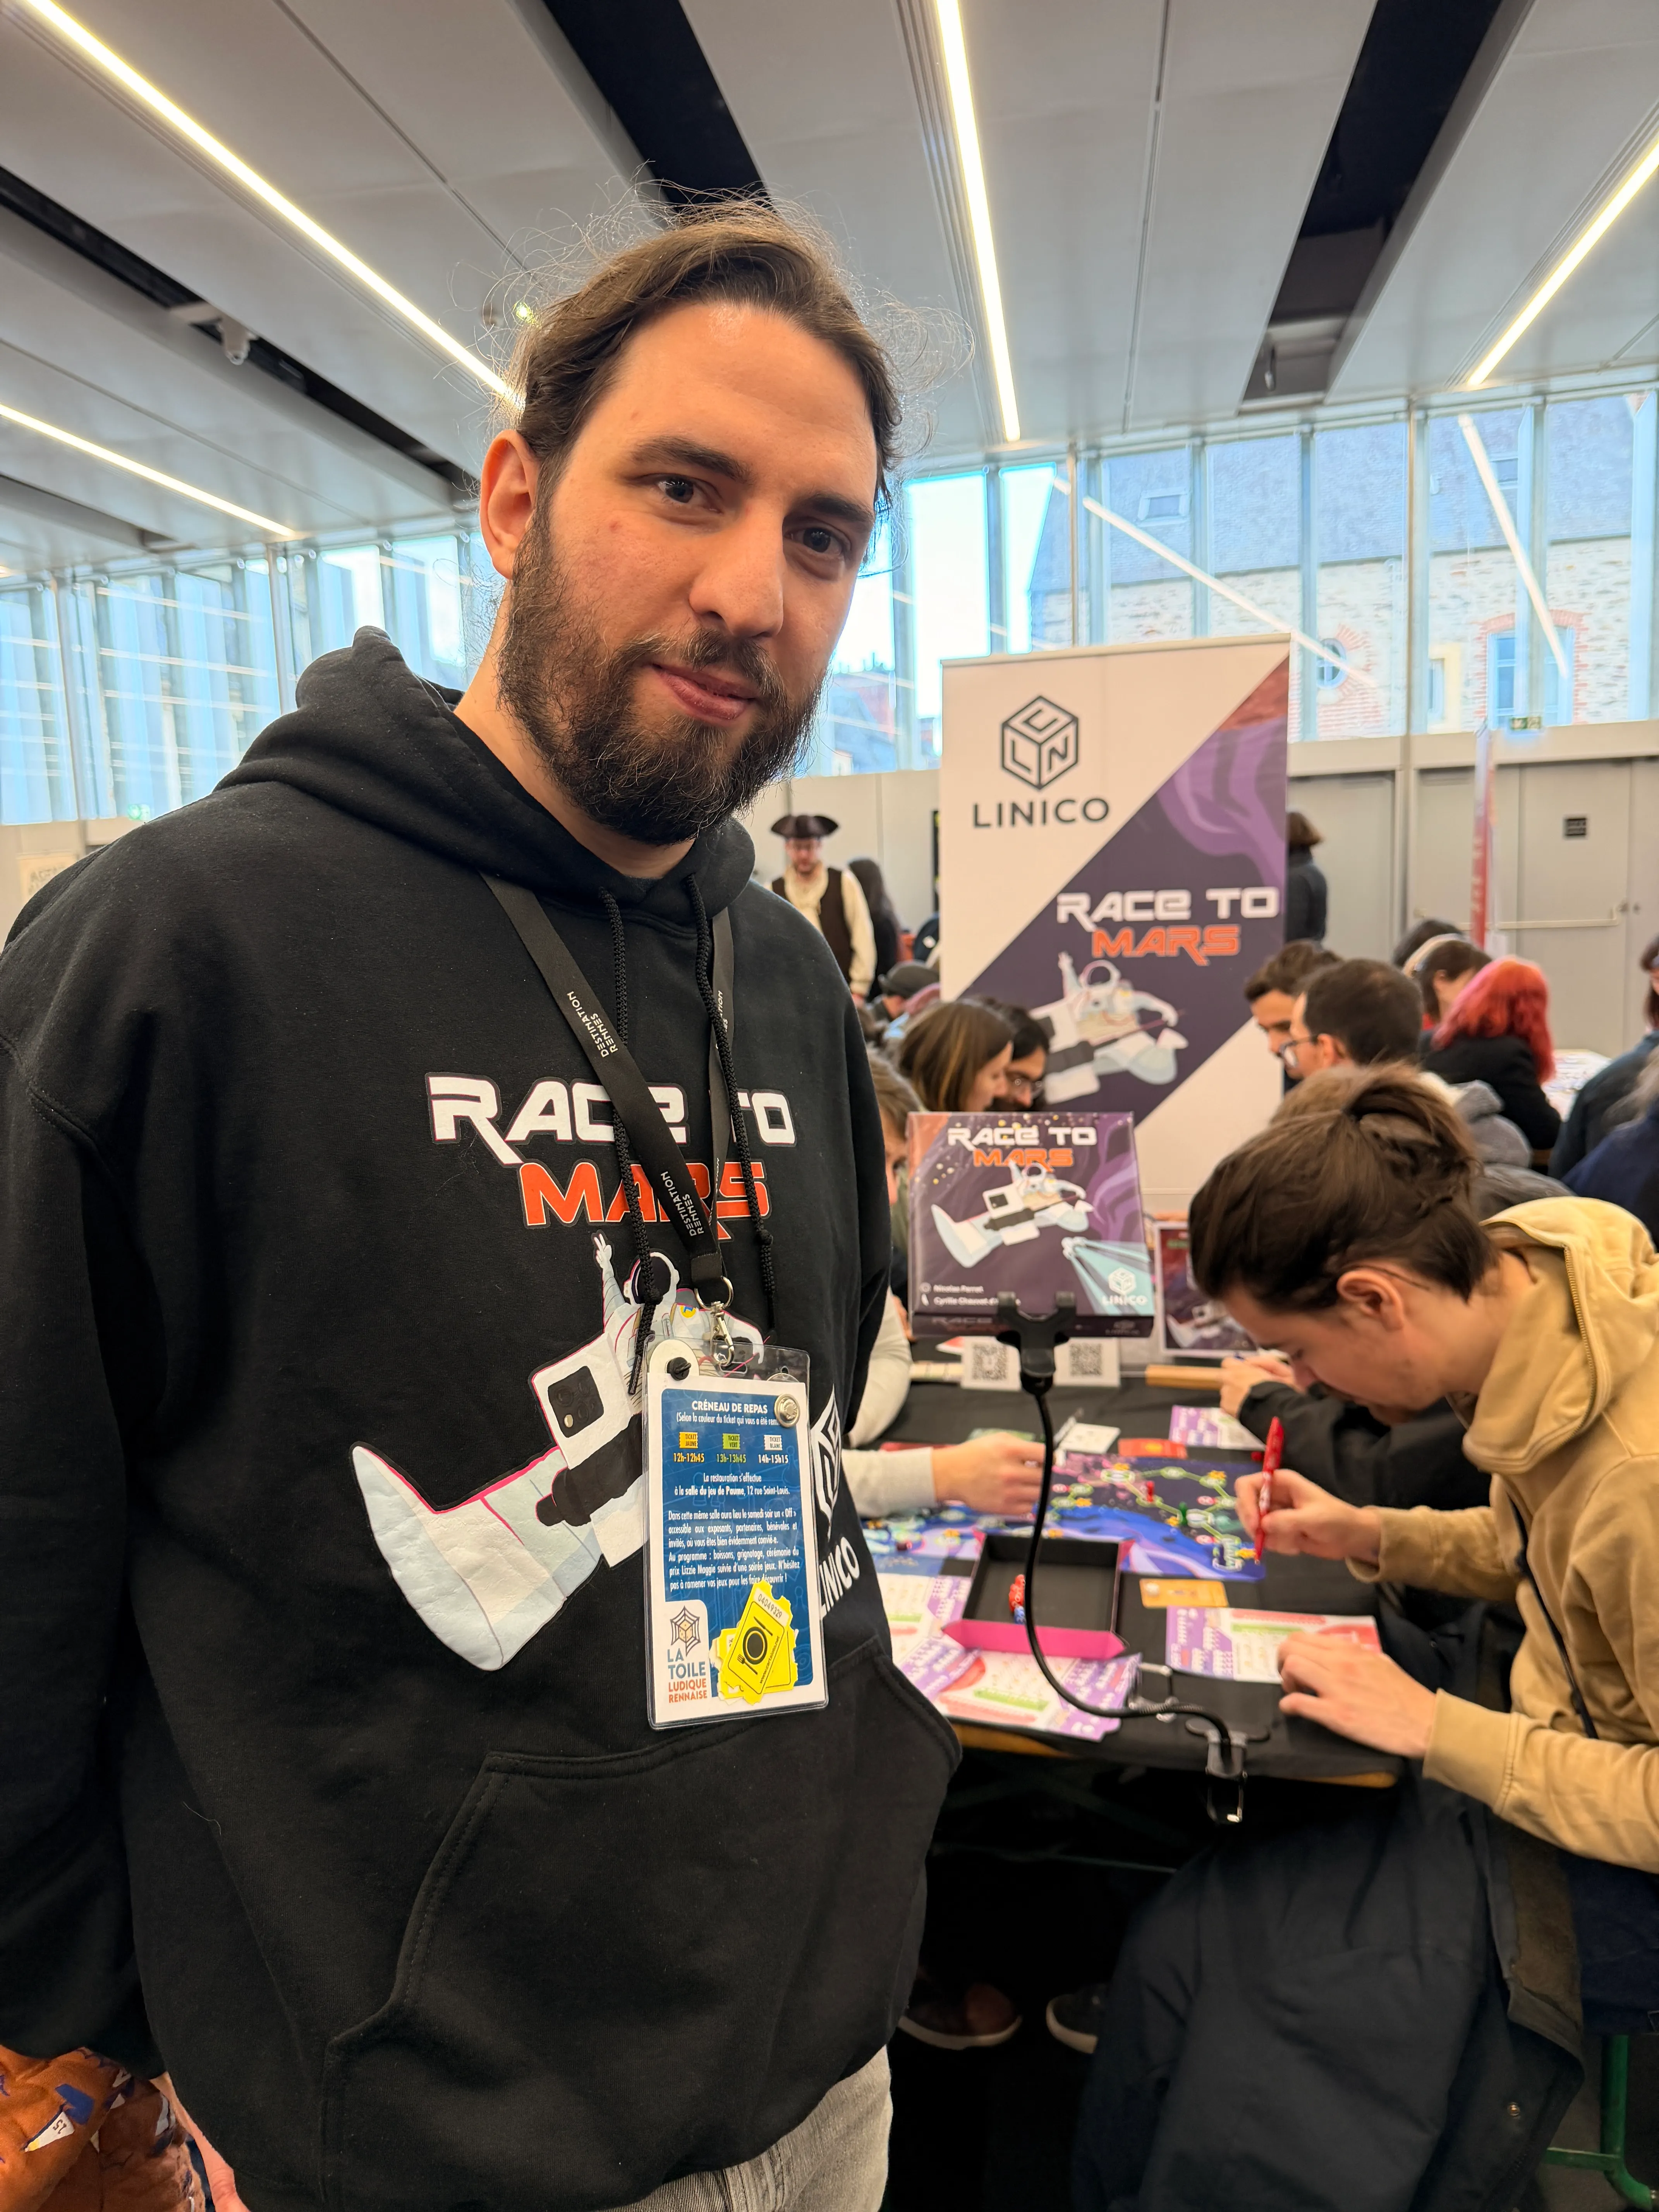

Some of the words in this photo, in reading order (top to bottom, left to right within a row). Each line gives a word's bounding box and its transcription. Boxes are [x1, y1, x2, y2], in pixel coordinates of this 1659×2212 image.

[973, 798, 1110, 828] LINICO
[1056, 890, 1192, 932] RACE
[1206, 886, 1279, 919] TO
[1092, 924, 1241, 966] MARS
[567, 991, 609, 1057] DESTINATION
[591, 1013, 618, 1053] RENNES
[947, 1127, 1040, 1151] RACE
[1048, 1127, 1097, 1146] TO
[973, 1148, 1073, 1173] MARS
[661, 1171, 696, 1236] DESTINATION
[683, 1194, 704, 1234] RENNES
[692, 1399, 730, 1412] CRÉNEAU
[732, 1403, 742, 1412] DE
[744, 1403, 768, 1414] REPAS
[677, 1411, 691, 1422] (Selon
[692, 1412, 697, 1422] la
[698, 1413, 715, 1423] couleur
[716, 1413, 722, 1423] du
[723, 1415, 735, 1424] ticket
[673, 1452, 704, 1462] 12h-12h45
[717, 1453, 746, 1463] 13h-13h45
[758, 1454, 788, 1463] 14h-15h15
[703, 1473, 709, 1482] La
[710, 1473, 738, 1482] restauration
[739, 1472, 762, 1482] s'effectue
[675, 1486, 678, 1495] à
[679, 1485, 684, 1495] la
[685, 1485, 698, 1495] salle
[699, 1485, 706, 1495] du
[708, 1486, 716, 1498] jeu
[718, 1485, 724, 1495] de
[726, 1486, 746, 1496] Paume,
[747, 1486, 754, 1495] 12
[763, 1486, 790, 1495] Saint-Louis.
[668, 1510, 680, 1520] Dans
[681, 1511, 693, 1520] cette
[694, 1510, 708, 1519] même
[709, 1509, 720, 1519] salle
[733, 1509, 741, 1519] lieu
[742, 1508, 747, 1518] le
[747, 1508, 764, 1518] samedi
[764, 1509, 773, 1518] soir
[668, 1523, 691, 1534] accessible
[708, 1524, 733, 1534] exposants,
[736, 1522, 763, 1534] partenaires,
[766, 1520, 789, 1531] bénévoles
[792, 1522, 797, 1530] et
[668, 1538, 685, 1549] invités,
[687, 1537, 693, 1547] où
[706, 1537, 716, 1546] êtes
[717, 1535, 727, 1546] bien
[728, 1535, 757, 1545] évidemment
[669, 1552, 675, 1562] Au
[678, 1553, 707, 1564] programme
[713, 1549, 735, 1560] boissons,
[737, 1549, 764, 1561] grignotage,
[766, 1547, 790, 1557] cérémonie
[792, 1546, 799, 1556] du
[669, 1566, 680, 1578] prix
[682, 1565, 696, 1575] Lizzie
[697, 1564, 716, 1576] Maggie
[717, 1563, 732, 1573] suivie
[733, 1561, 747, 1572] d'une
[748, 1561, 763, 1571] soirée
[764, 1561, 777, 1572] jeux.
[778, 1559, 800, 1569] N'hésitez
[670, 1582, 679, 1592] pas
[680, 1580, 684, 1589] à
[685, 1580, 706, 1589] ramener
[716, 1577, 727, 1589] jeux
[728, 1578, 740, 1588] pour
[749, 1574, 761, 1585] faire
[758, 1594, 782, 1619] 04049329
[668, 1648, 684, 1662] LA
[668, 1661, 706, 1680] TOILE
[668, 1678, 707, 1692] LUDIQUE
[669, 1690, 708, 1703] RENNAISE
